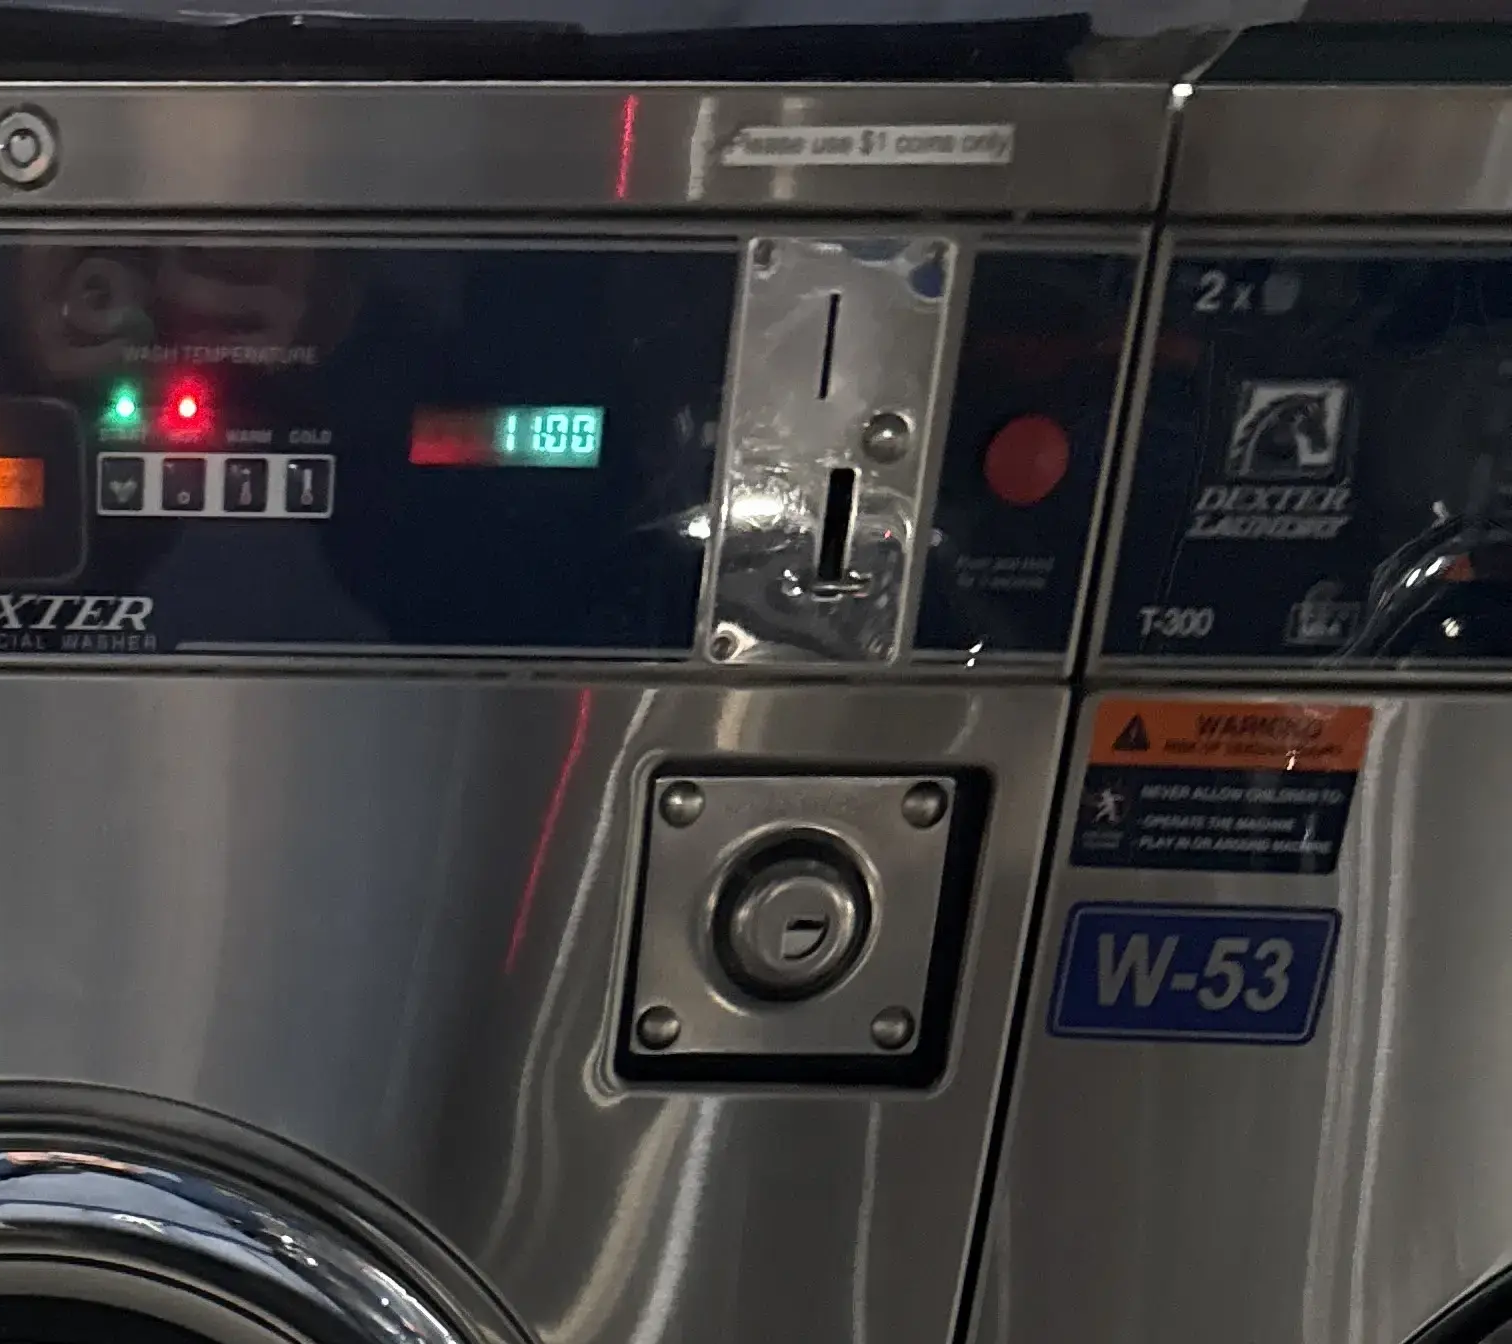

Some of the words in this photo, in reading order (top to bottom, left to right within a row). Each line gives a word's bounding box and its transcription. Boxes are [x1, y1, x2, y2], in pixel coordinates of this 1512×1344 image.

[1194, 270, 1227, 312] 2
[1233, 284, 1254, 311] x
[1194, 485, 1352, 511] DEXTER
[1139, 606, 1216, 637] T-300
[61, 633, 157, 650] WASHER
[1139, 835, 1173, 850] PLAY
[1097, 933, 1295, 1012] W-53
